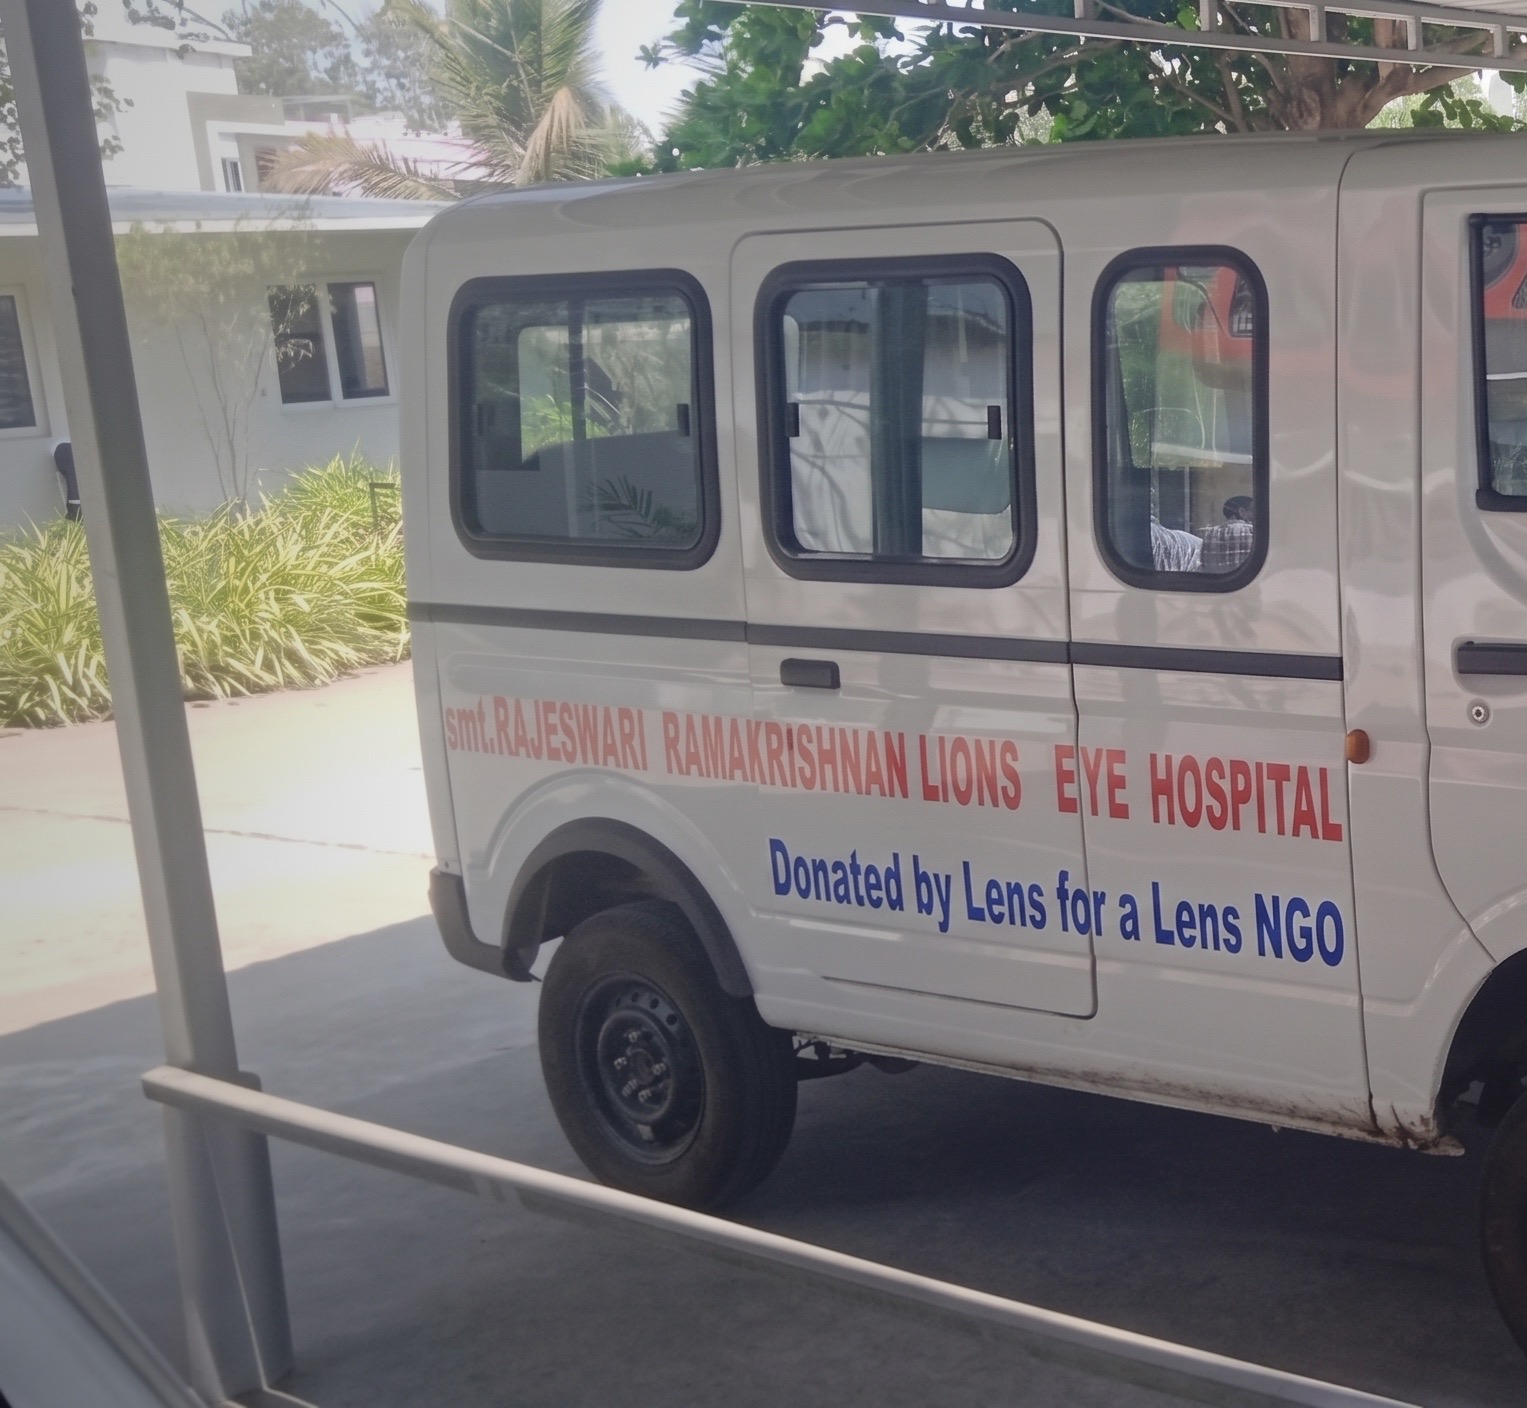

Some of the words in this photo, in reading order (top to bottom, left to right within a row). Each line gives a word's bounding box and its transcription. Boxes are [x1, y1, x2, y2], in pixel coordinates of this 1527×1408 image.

[662, 711, 908, 799] RAMAKRISHNAN
[919, 735, 1022, 810] LIONS
[1055, 744, 1129, 819] EYE
[1150, 753, 1343, 841] HOSPITAL
[769, 838, 905, 911] Donated
[912, 855, 952, 933] by
[963, 861, 1047, 929] Lens
[1056, 870, 1106, 936] for
[1119, 894, 1140, 940] a
[1151, 881, 1243, 953] Lens
[1254, 893, 1344, 966] NGO
